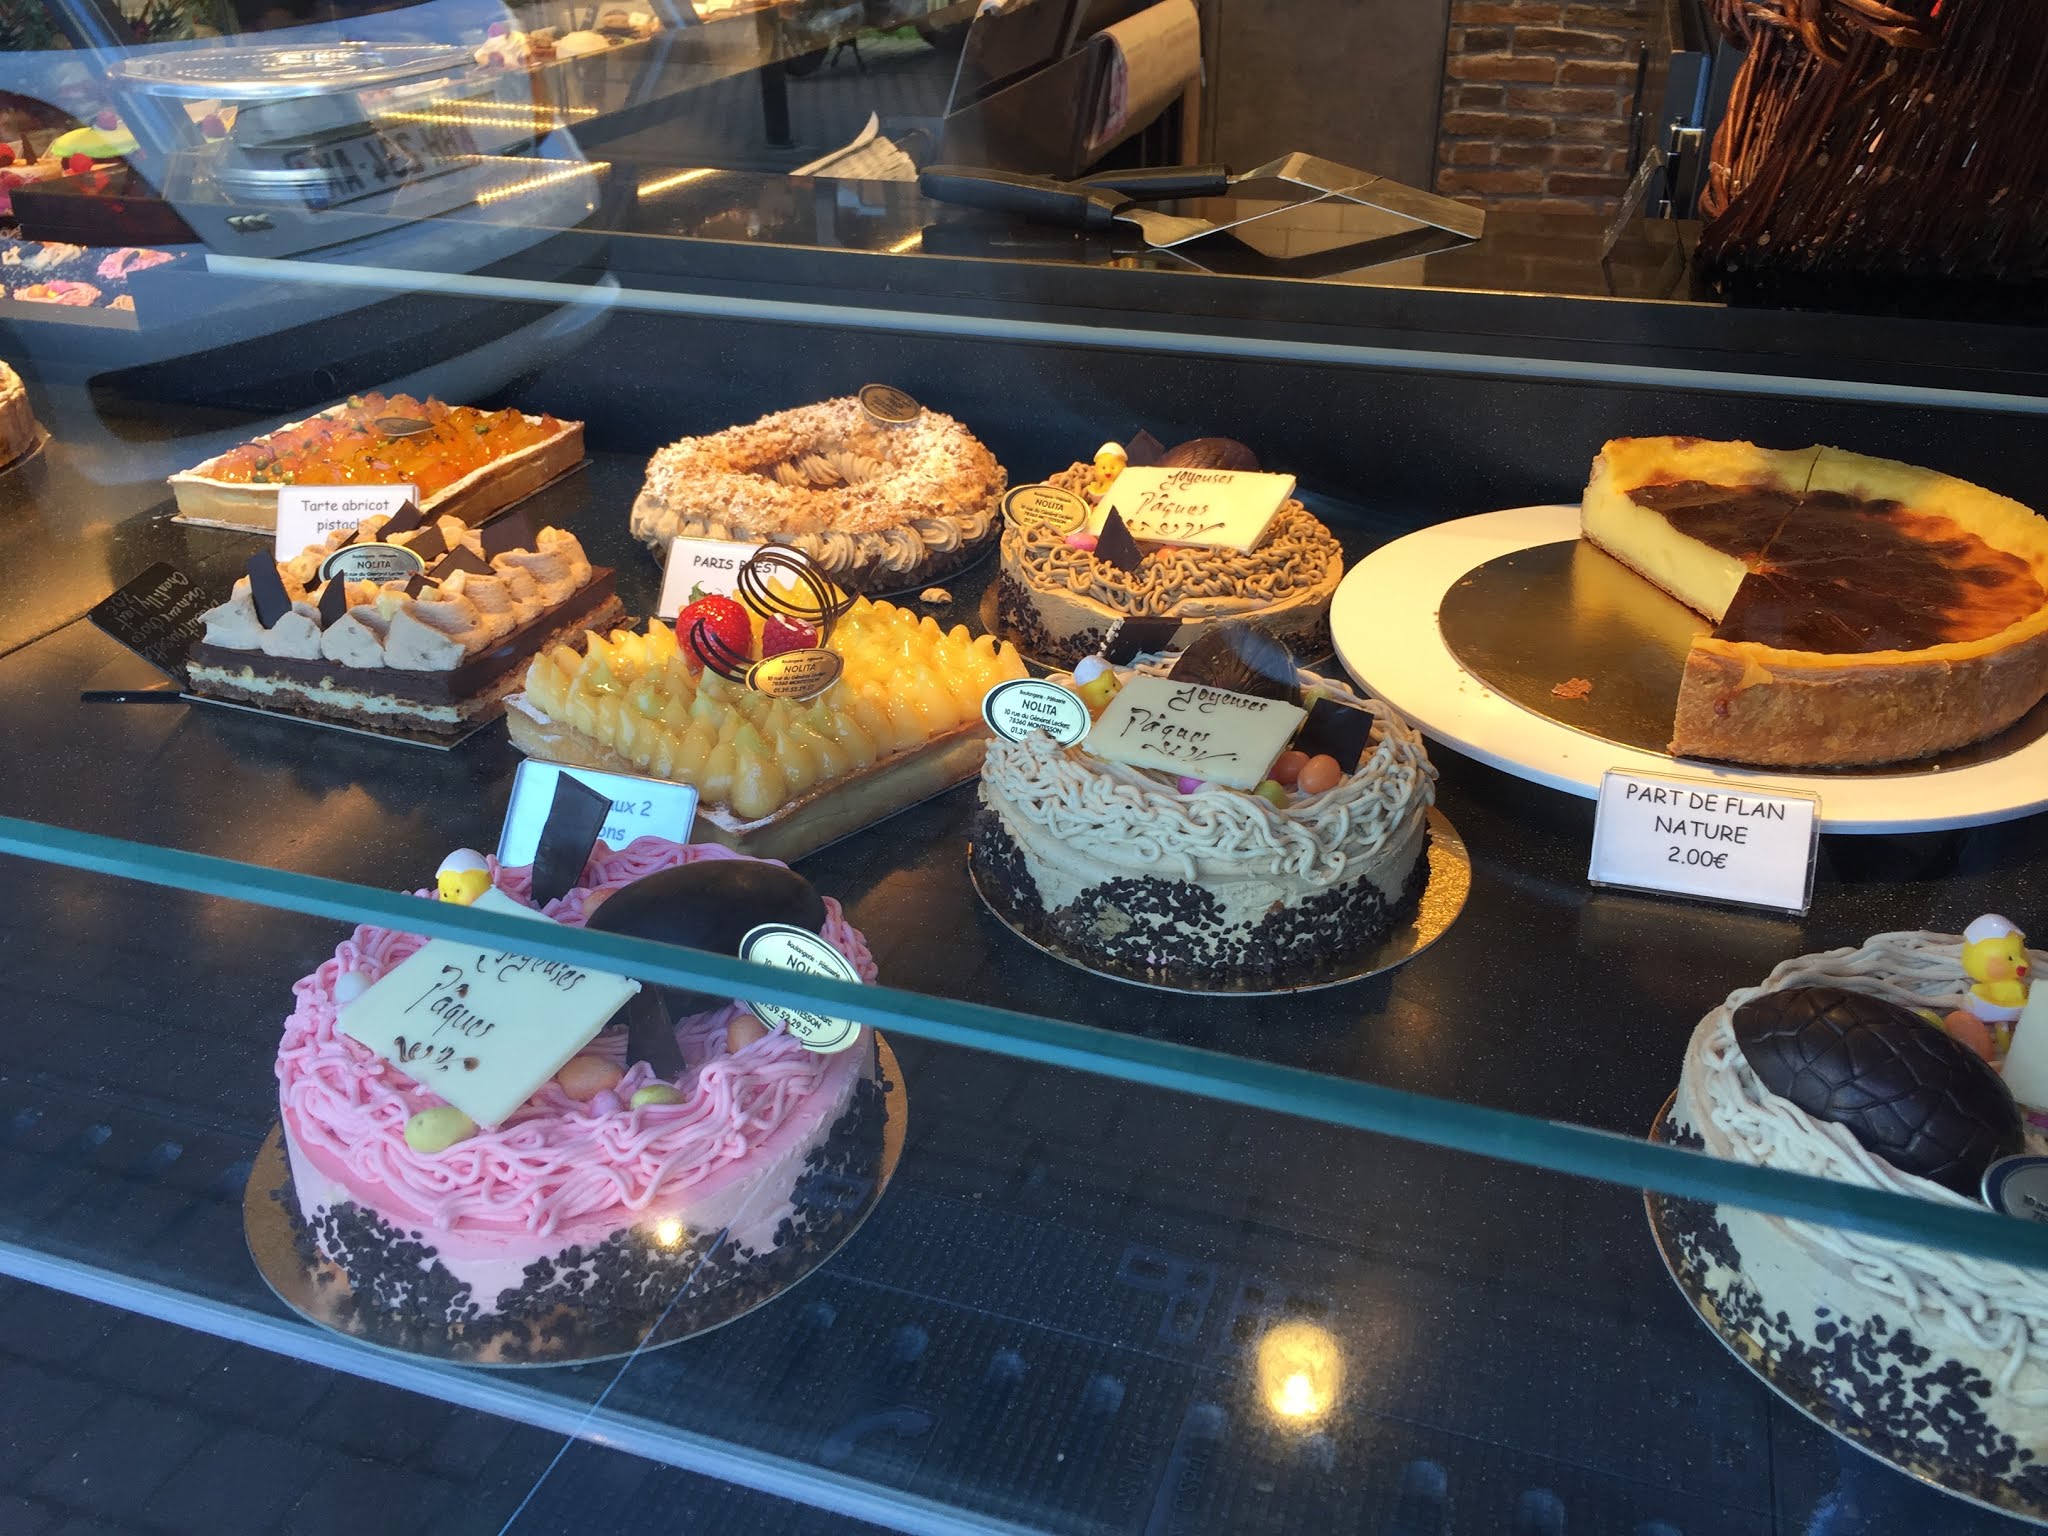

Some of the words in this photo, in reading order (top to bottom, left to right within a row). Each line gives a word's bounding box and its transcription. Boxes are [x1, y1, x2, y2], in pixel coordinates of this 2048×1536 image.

[1160, 471, 1235, 491] Joyeuses
[301, 500, 338, 512] Tarte
[342, 500, 390, 512] abricot
[1035, 499, 1064, 511] NOLITA
[1136, 492, 1210, 518] Pâques
[357, 560, 391, 569] NOLITA
[694, 556, 734, 570] PARIS
[739, 559, 778, 574] BEST
[784, 663, 816, 673] NOLITA
[1022, 699, 1057, 716] NOLITA
[1168, 686, 1268, 714] Joyeuses
[1120, 707, 1210, 742] Pâques
[640, 801, 653, 816] 2
[1626, 783, 1684, 806] PART
[1689, 792, 1719, 812] DE
[1725, 797, 1785, 820] FLAN
[1655, 815, 1748, 844] NATURE
[1668, 846, 1728, 869] 2.00€
[405, 965, 495, 1037] Pâques
